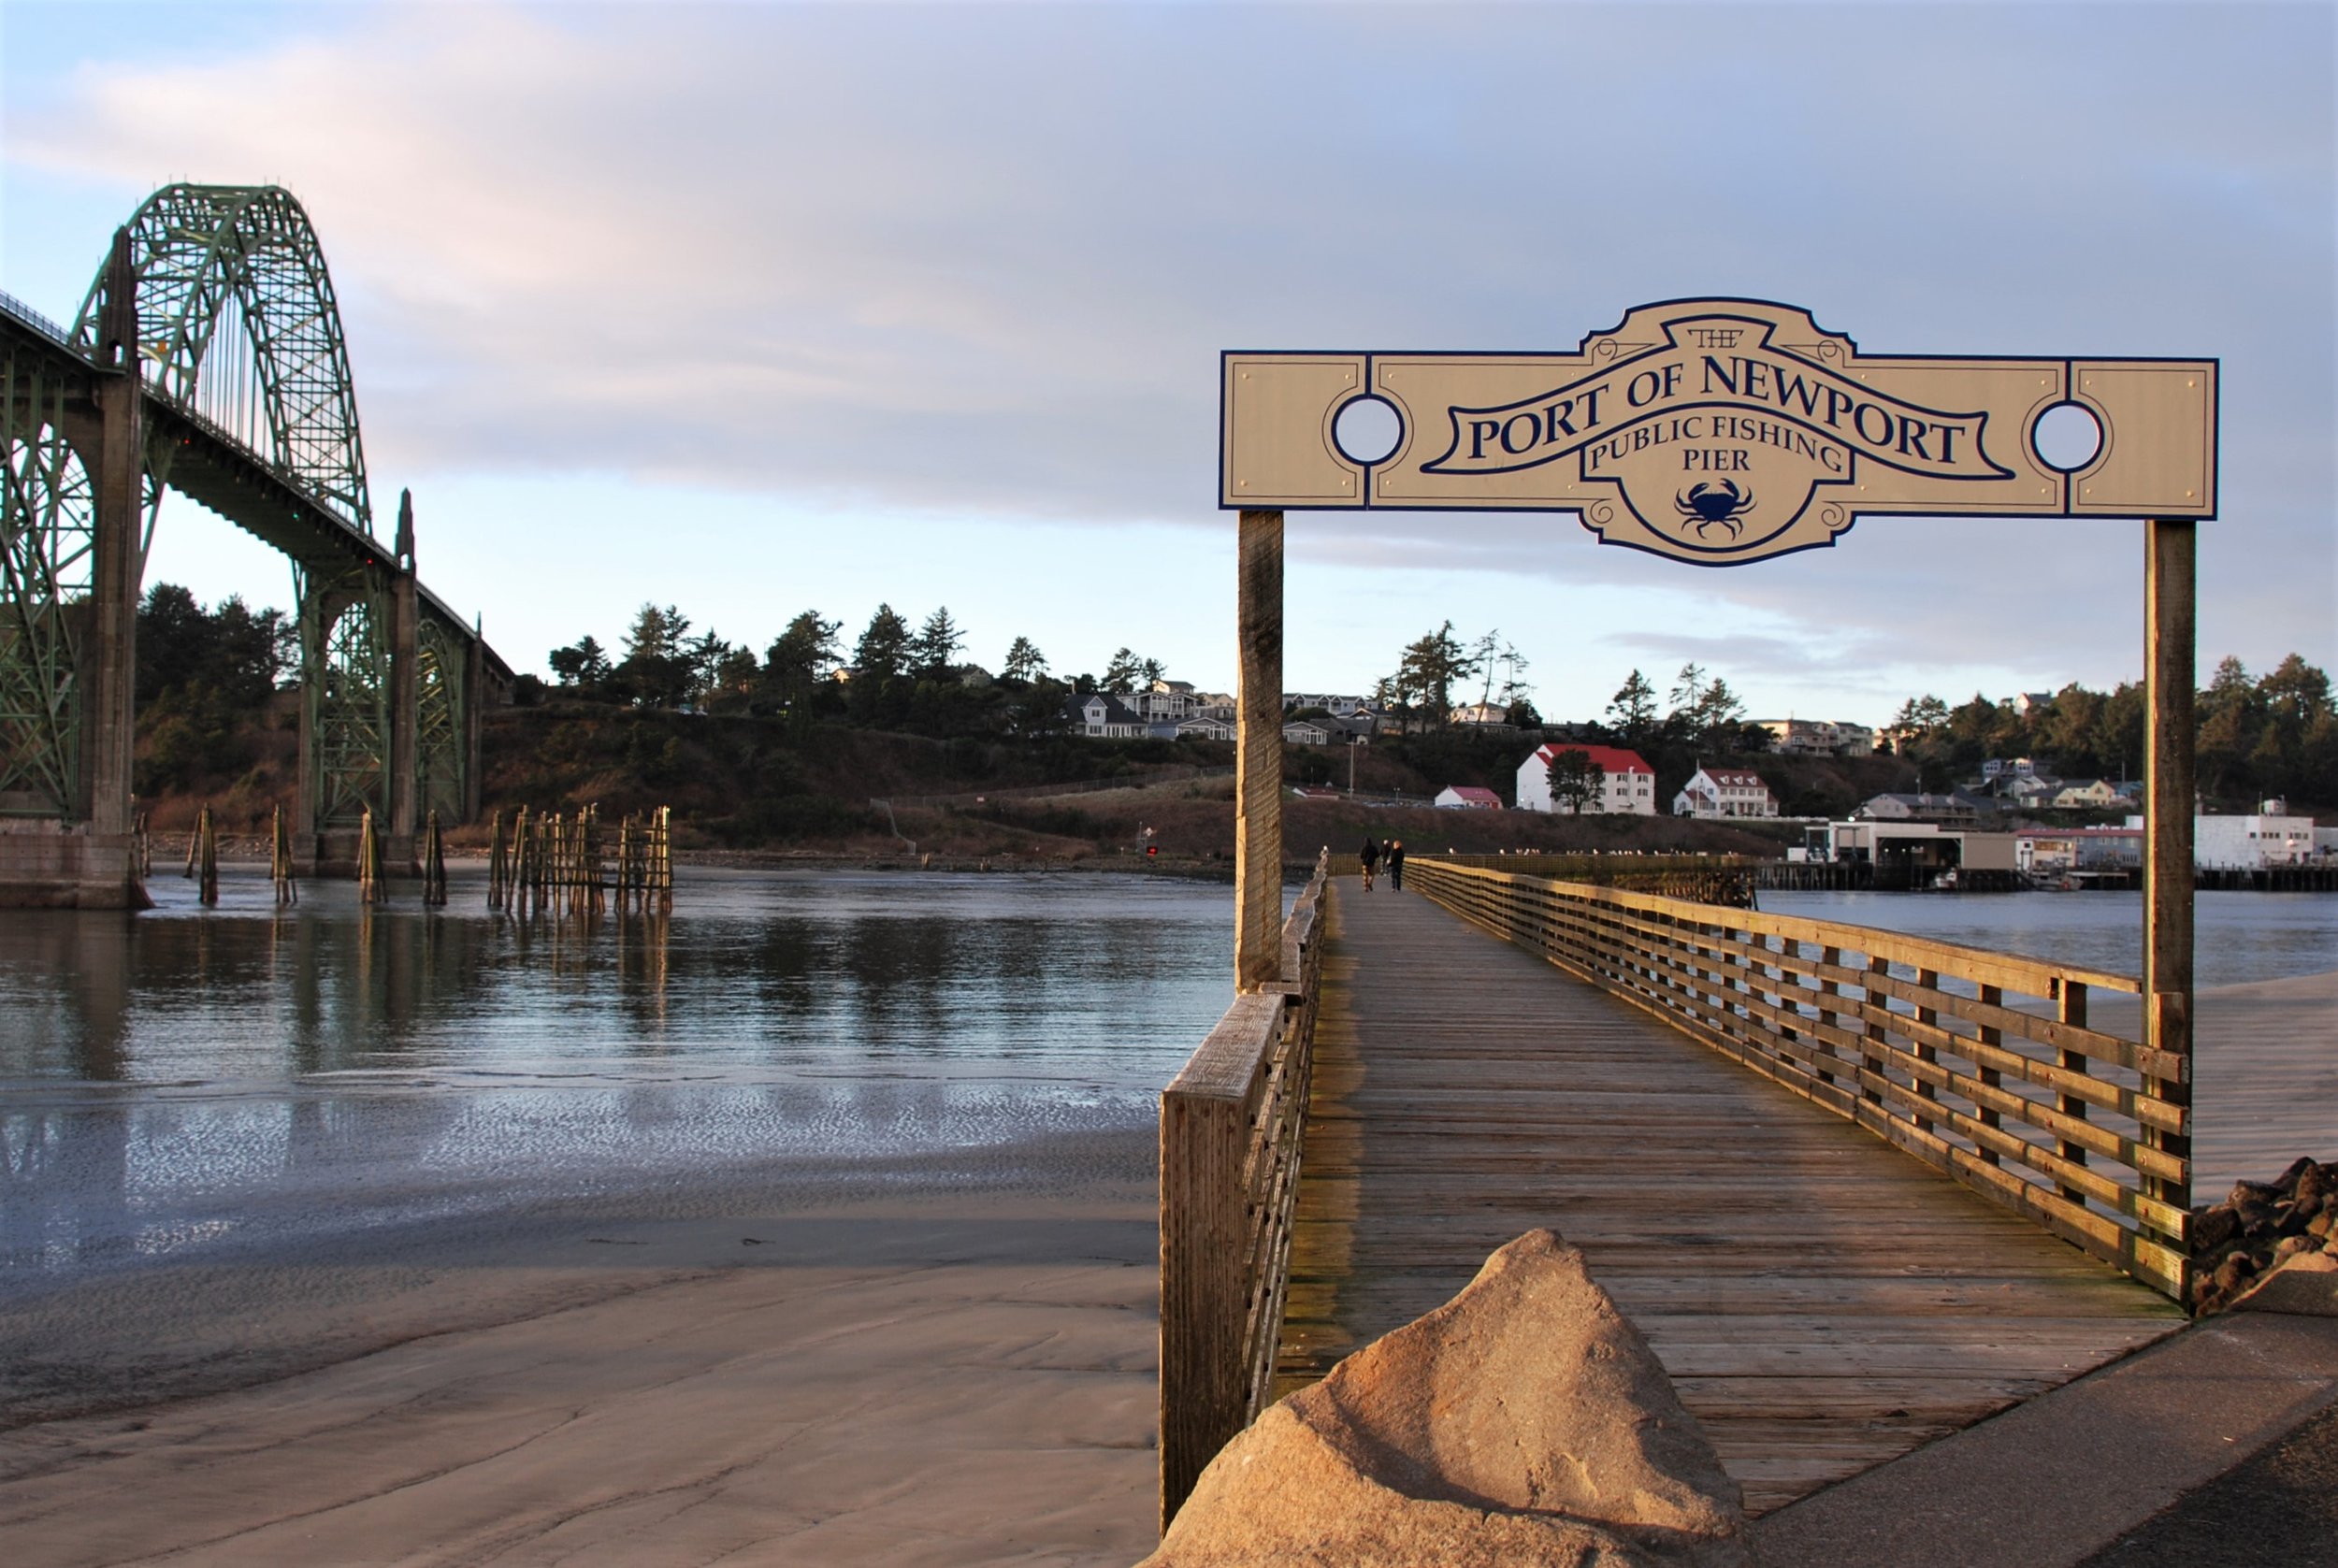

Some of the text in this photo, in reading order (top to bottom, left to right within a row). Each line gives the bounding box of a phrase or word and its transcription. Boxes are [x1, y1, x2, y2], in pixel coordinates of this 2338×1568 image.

[1686, 328, 1744, 349] THE
[1467, 354, 1966, 465] PORT OF NEWPORT
[1590, 415, 1842, 473] PUBLIC FISHING
[1682, 449, 1751, 471] PIER
